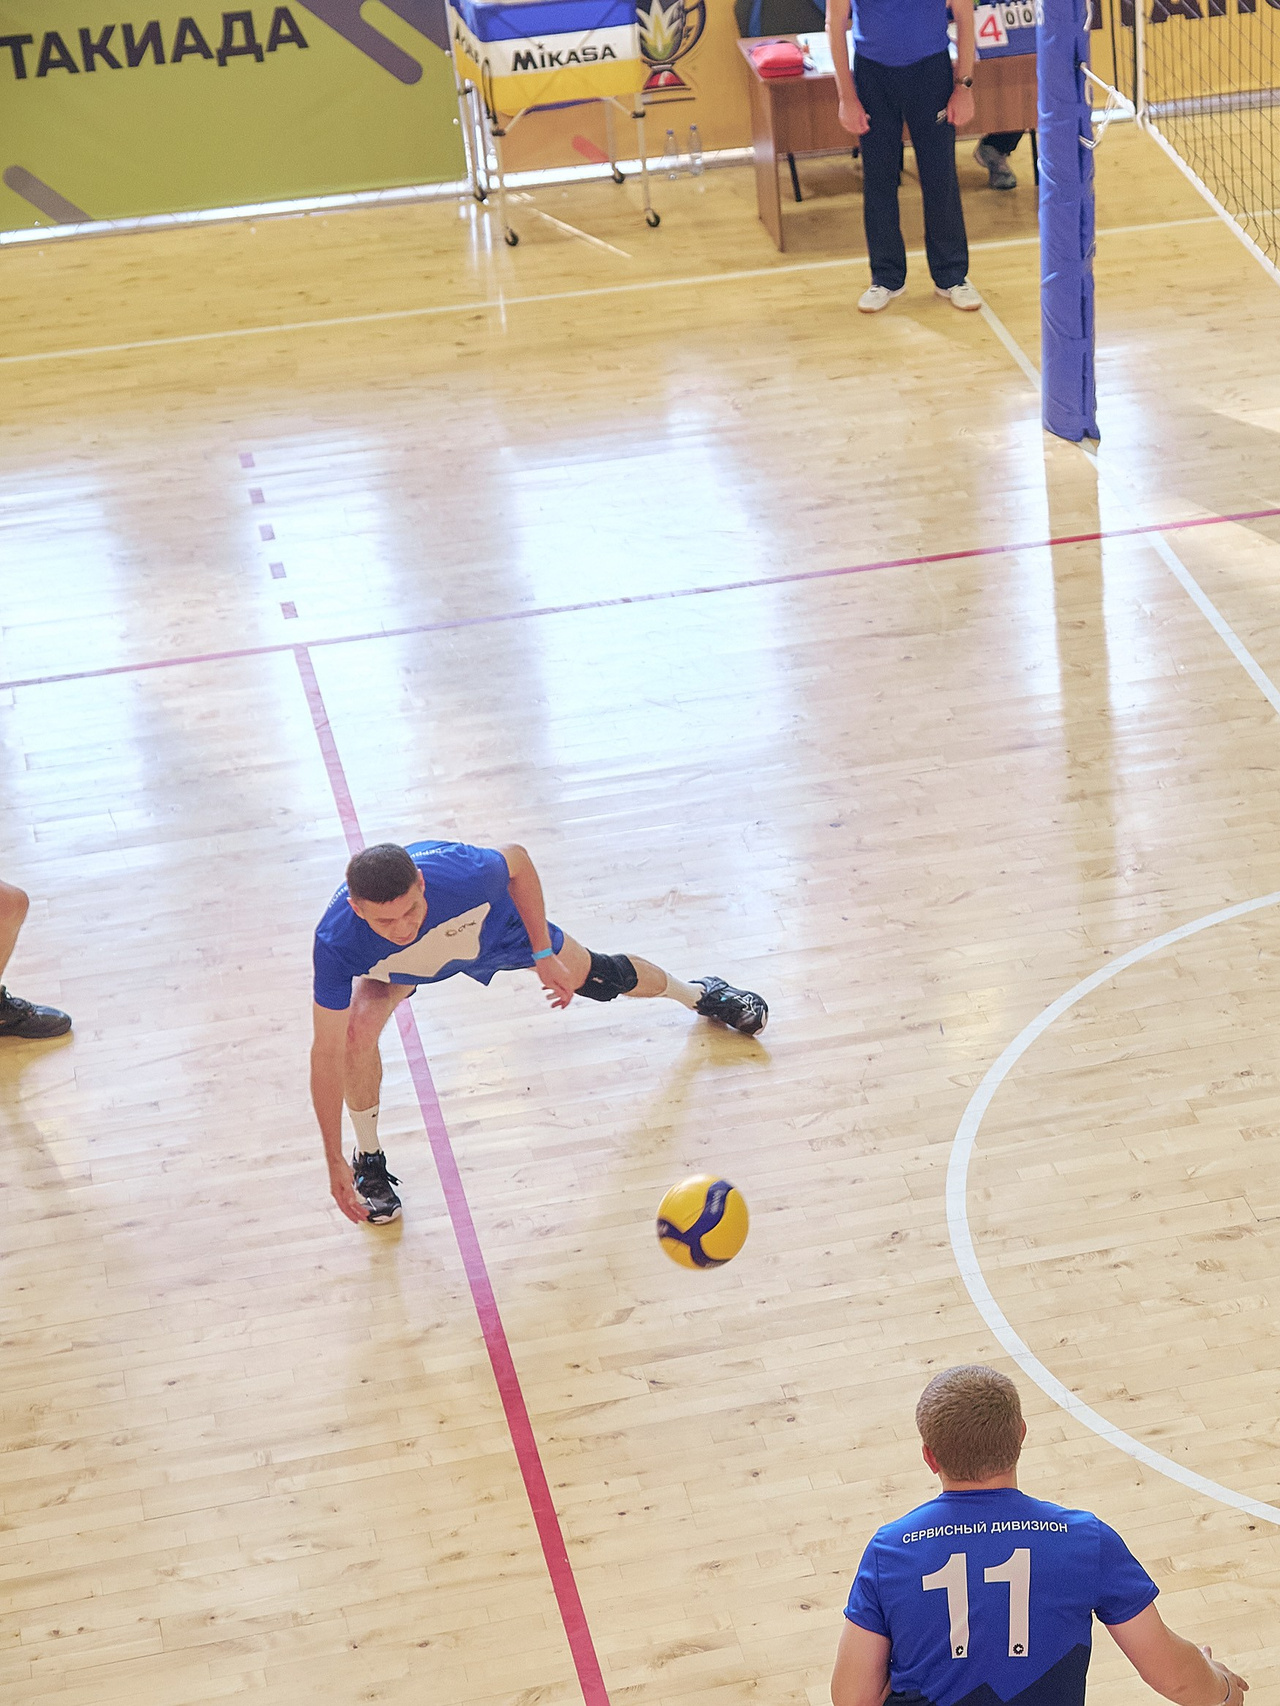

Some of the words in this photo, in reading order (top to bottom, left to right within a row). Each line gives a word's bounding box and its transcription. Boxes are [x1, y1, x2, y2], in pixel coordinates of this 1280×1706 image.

[0, 6, 309, 80] ТАКИАДА
[979, 14, 1002, 41] 4
[902, 1521, 988, 1544] СЕРВИСНЫЙ
[990, 1520, 1068, 1533] ДИВИЗИОН
[922, 1548, 1031, 1659] 11
